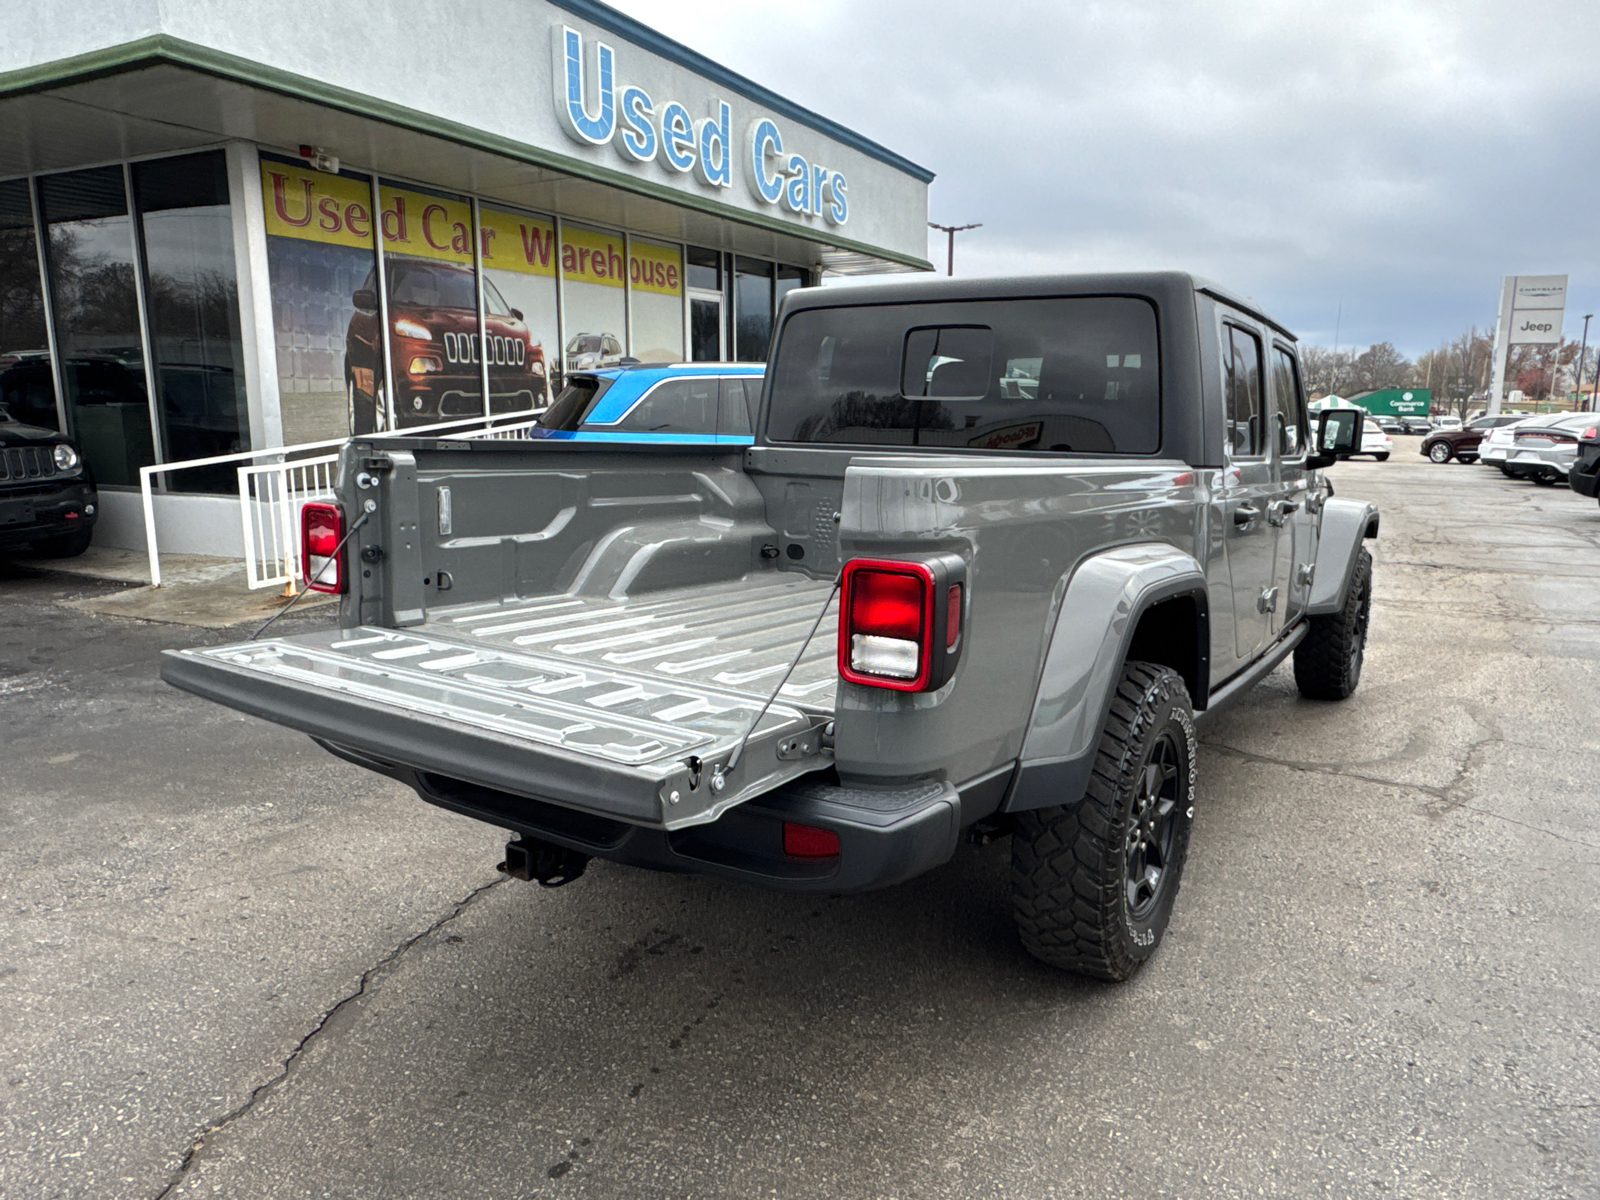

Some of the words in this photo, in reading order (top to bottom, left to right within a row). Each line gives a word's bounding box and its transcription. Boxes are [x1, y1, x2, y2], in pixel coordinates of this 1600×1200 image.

[559, 24, 732, 188] Used
[750, 118, 849, 226] Cars
[267, 171, 410, 243] Used
[422, 203, 495, 259] Car
[519, 223, 679, 289] Warehouse
[1520, 321, 1552, 332] Jeep
